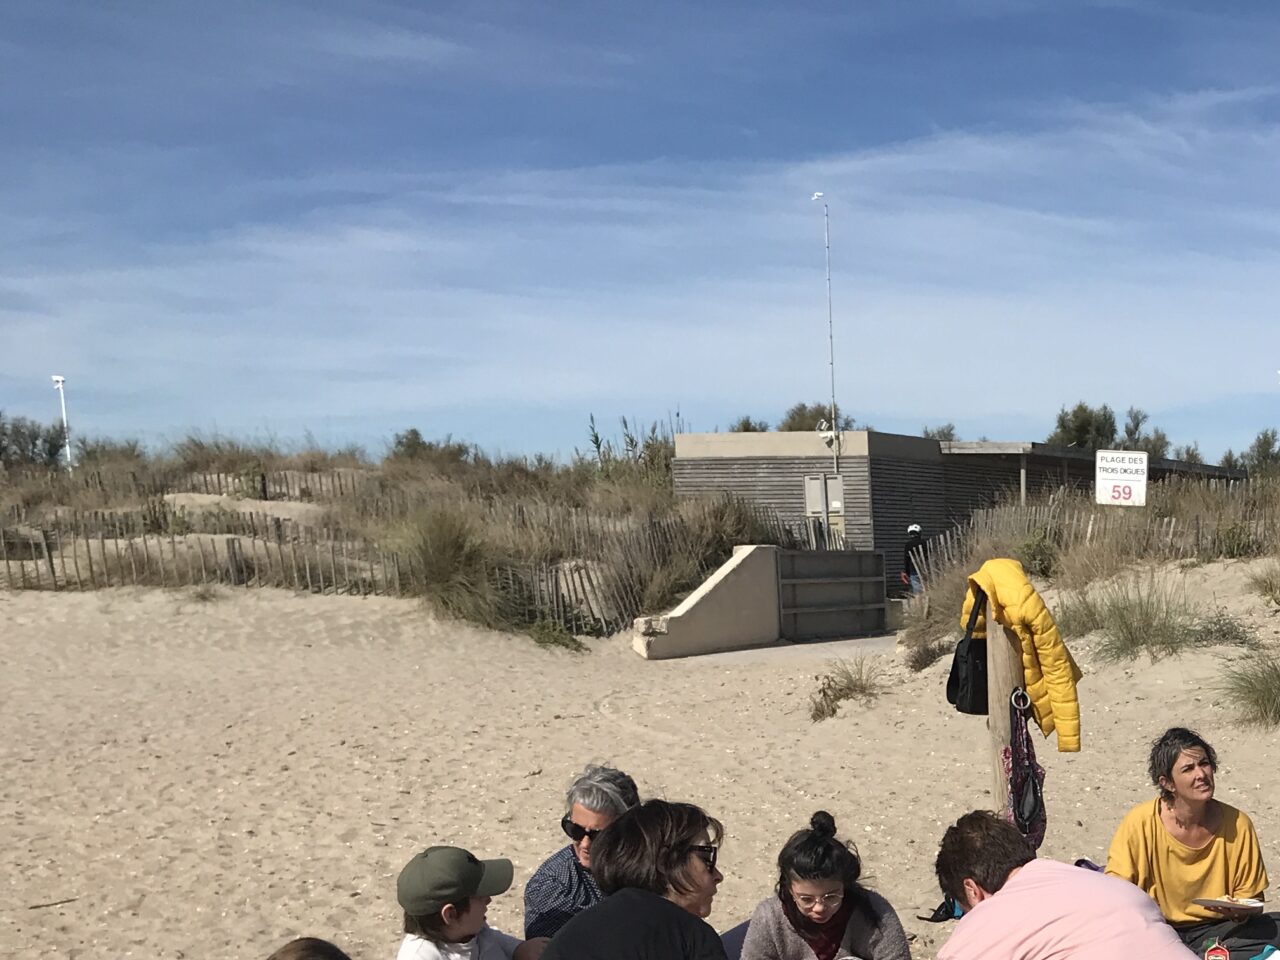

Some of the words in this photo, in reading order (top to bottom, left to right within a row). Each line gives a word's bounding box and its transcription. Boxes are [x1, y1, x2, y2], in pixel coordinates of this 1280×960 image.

[1100, 456, 1126, 464] PLAGE
[1098, 466, 1119, 474] TROIS
[1119, 467, 1146, 476] DIGUES
[1111, 485, 1132, 500] 59
